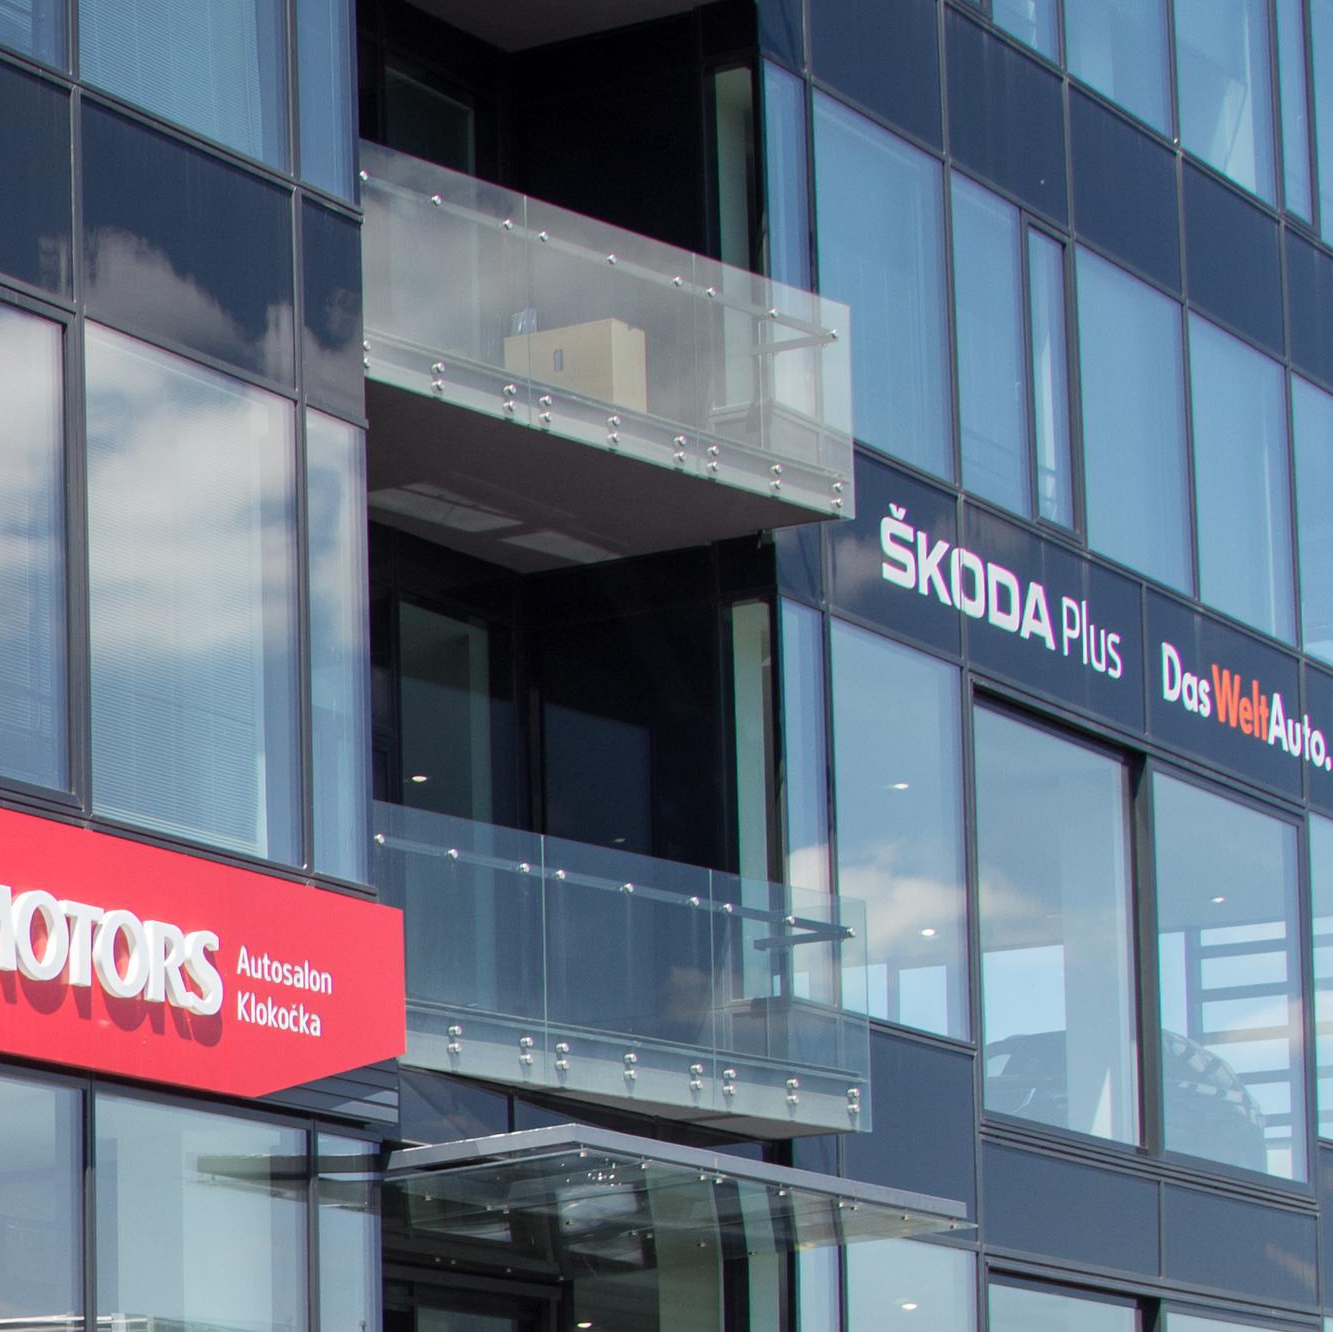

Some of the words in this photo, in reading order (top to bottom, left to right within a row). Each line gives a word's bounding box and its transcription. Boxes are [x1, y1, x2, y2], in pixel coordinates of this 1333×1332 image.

[880, 503, 1055, 651] ŠKODA
[1061, 596, 1122, 679] Plus
[236, 945, 333, 996] Autosalon
[236, 990, 322, 1037] Klokočka
